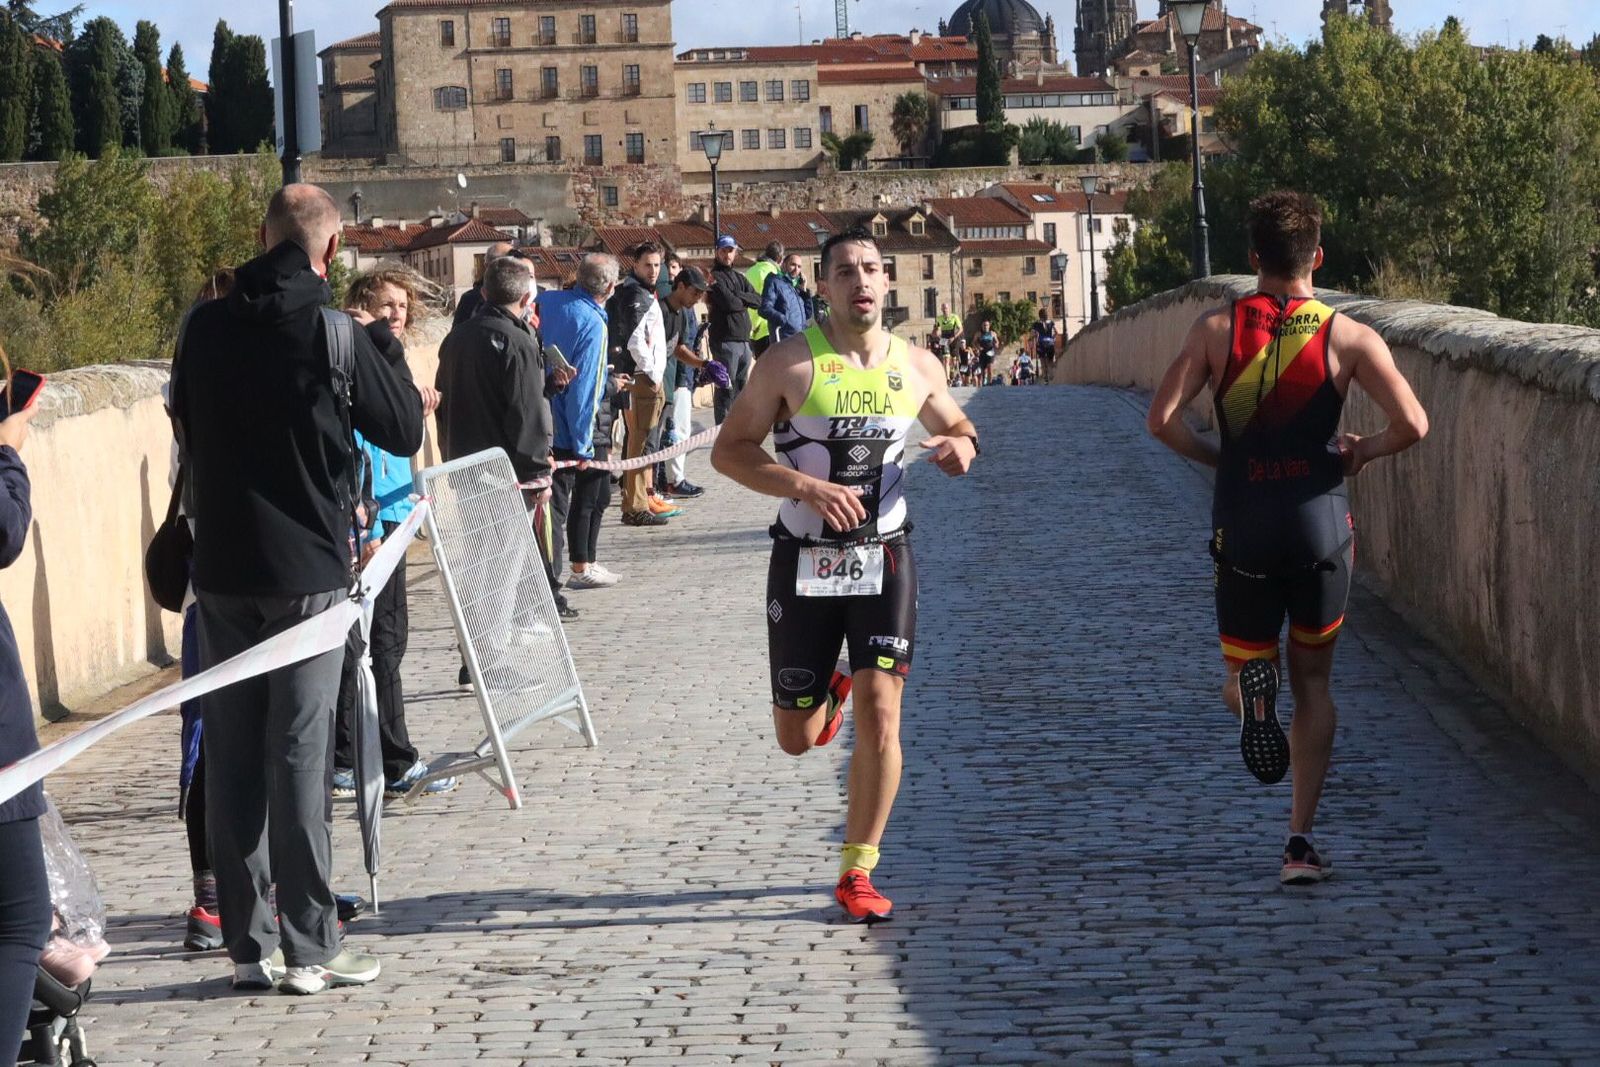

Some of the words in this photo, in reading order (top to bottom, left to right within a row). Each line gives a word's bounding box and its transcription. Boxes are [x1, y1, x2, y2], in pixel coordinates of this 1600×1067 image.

[834, 390, 894, 415] MORLA
[828, 416, 869, 429] TRI
[817, 556, 863, 581] 846
